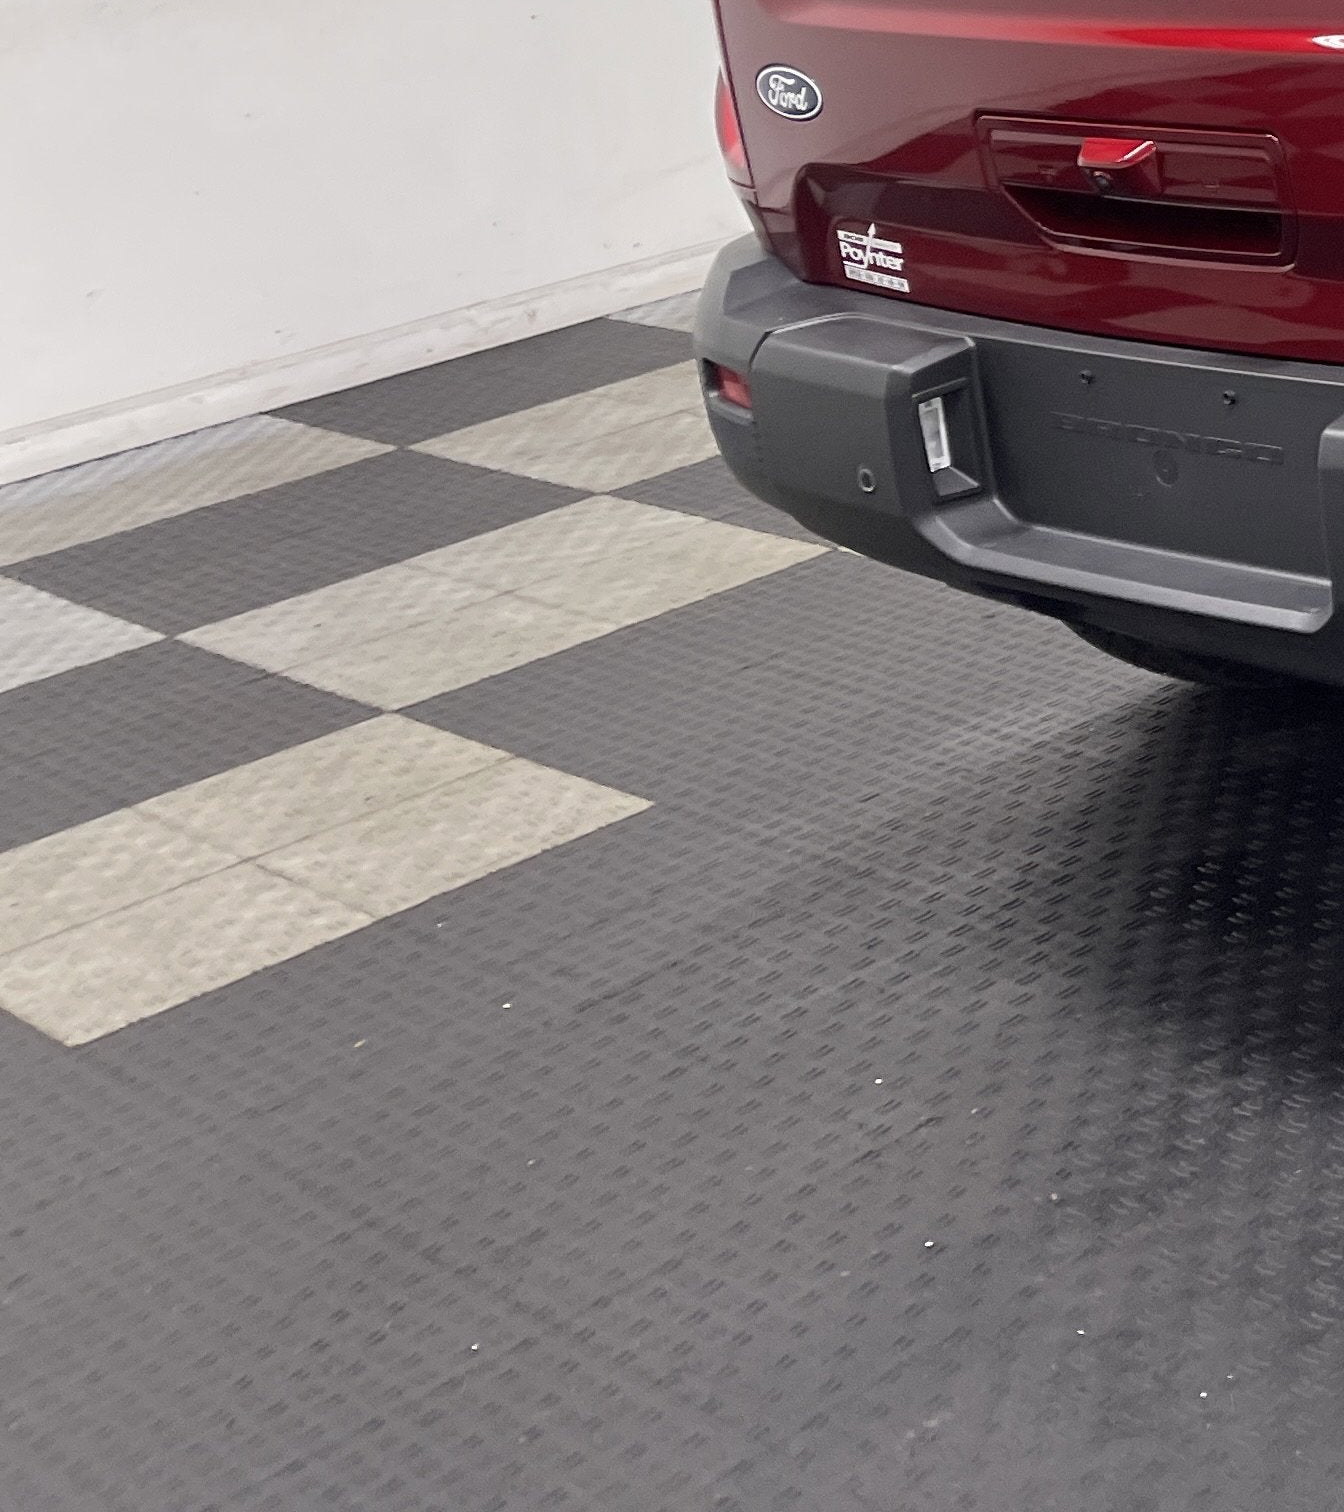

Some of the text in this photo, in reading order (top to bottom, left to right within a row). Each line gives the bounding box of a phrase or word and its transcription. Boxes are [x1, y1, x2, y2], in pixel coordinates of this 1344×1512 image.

[767, 73, 809, 112] Ford
[839, 241, 904, 271] Poynter
[1049, 410, 1285, 466] BRONCO
